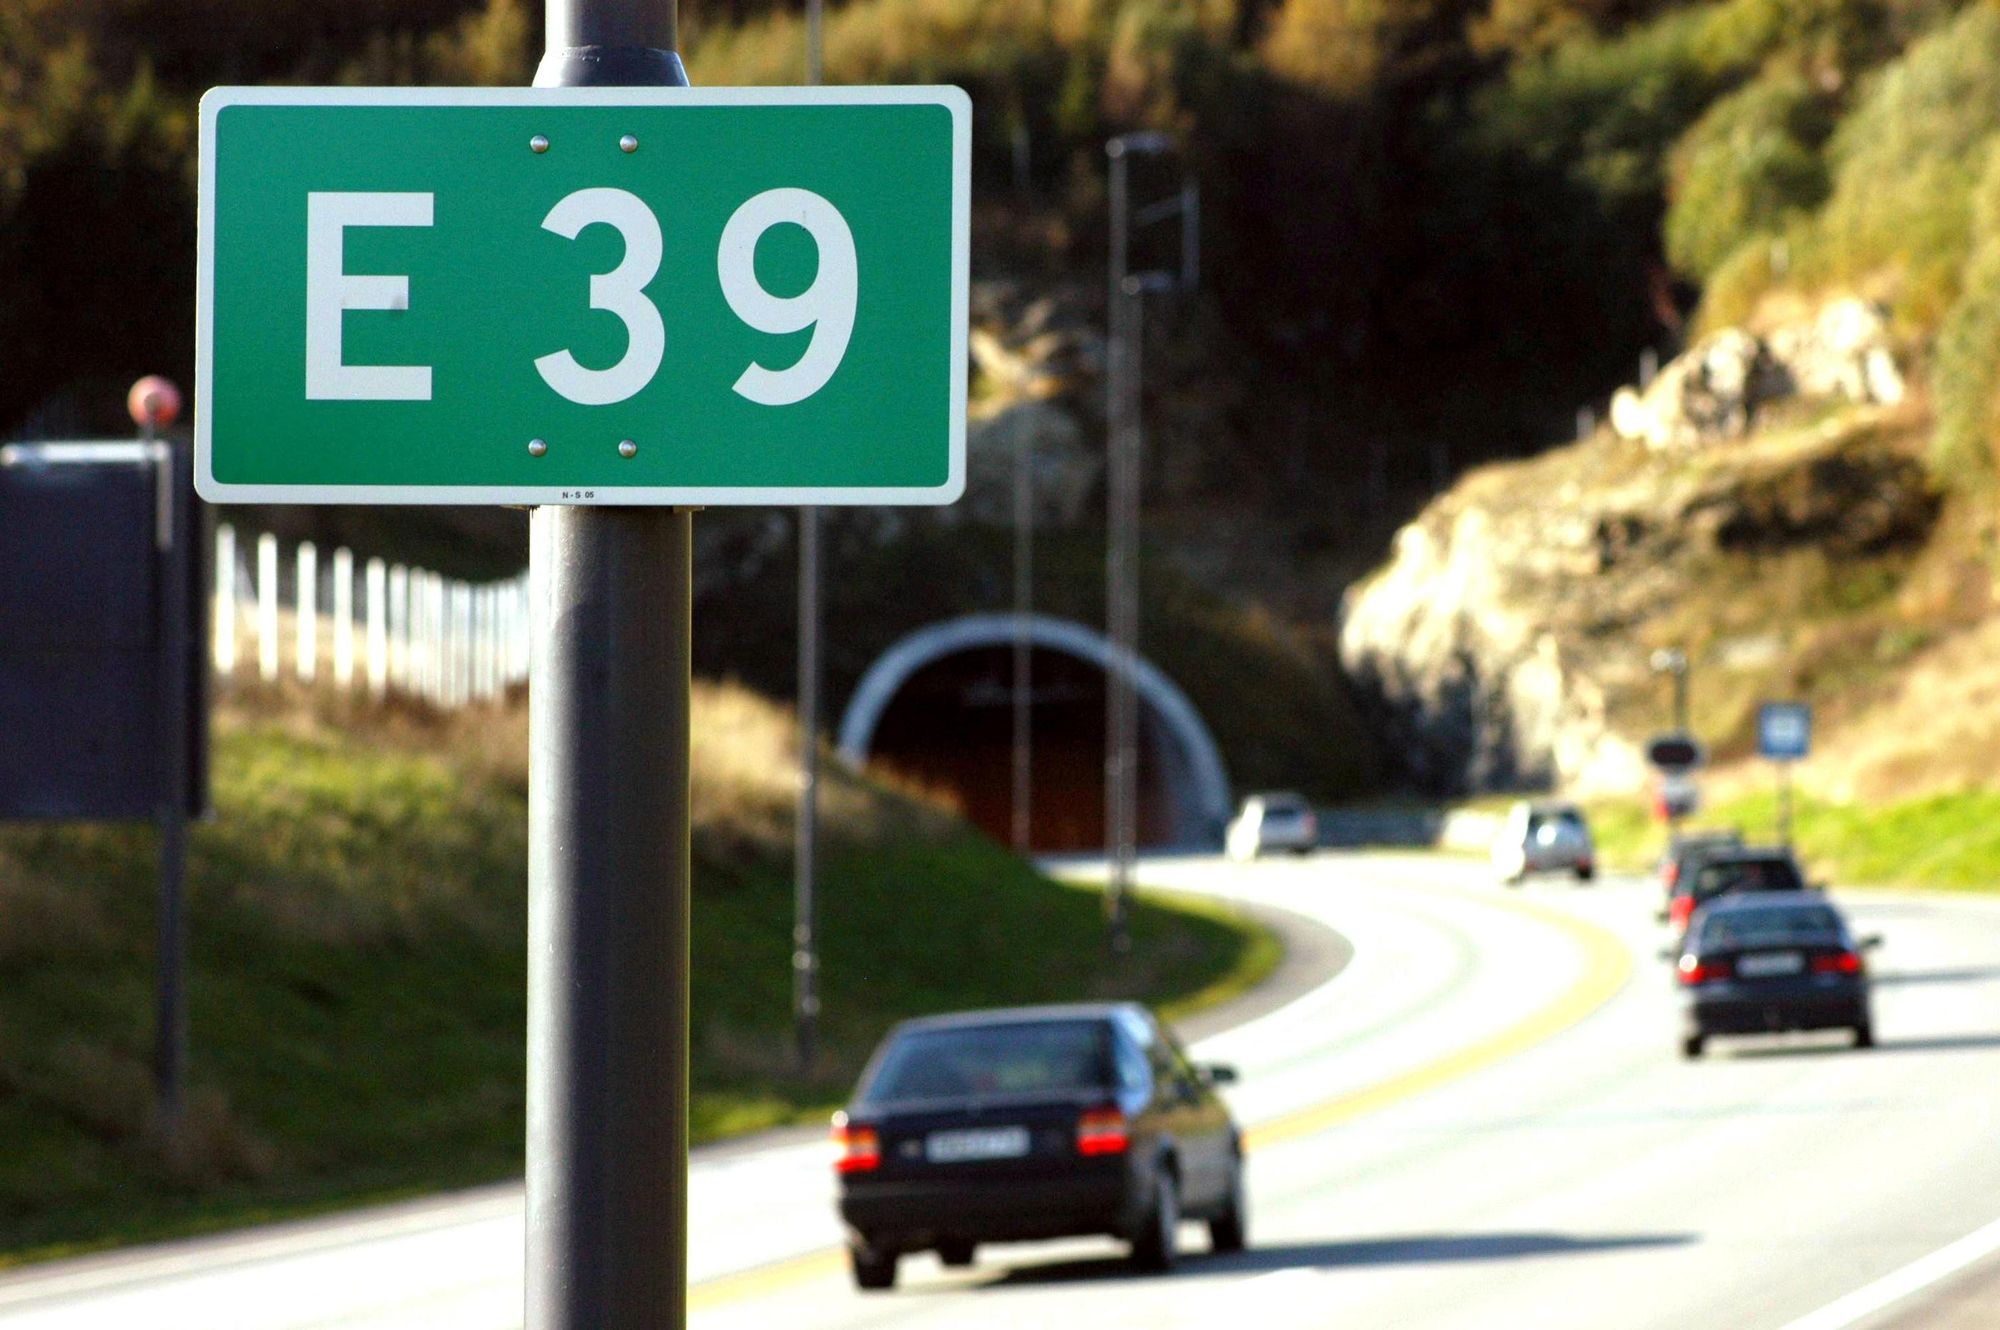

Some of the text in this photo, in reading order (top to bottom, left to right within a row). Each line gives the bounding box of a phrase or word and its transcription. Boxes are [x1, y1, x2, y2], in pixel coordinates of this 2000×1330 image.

[305, 187, 858, 406] E 39
[584, 491, 594, 499] 05
